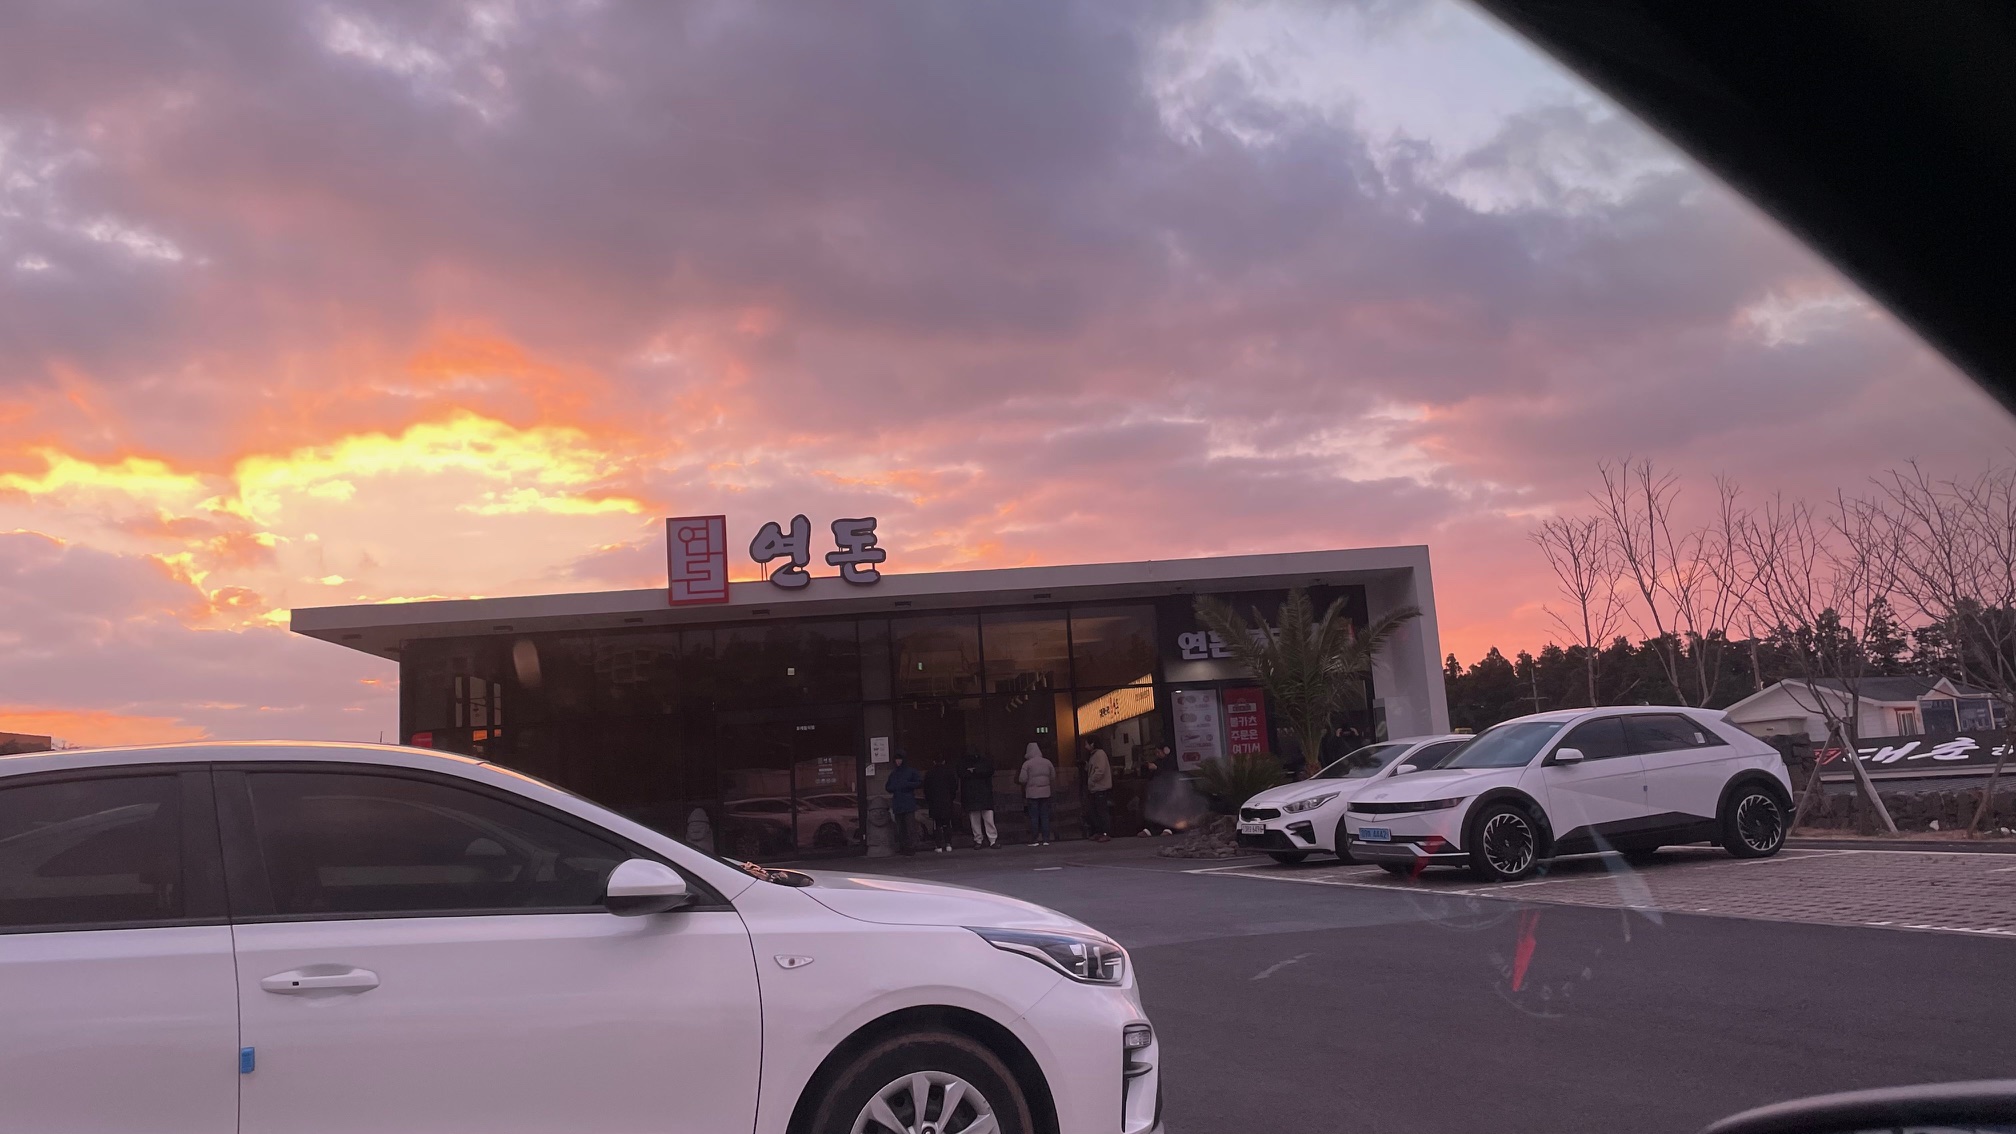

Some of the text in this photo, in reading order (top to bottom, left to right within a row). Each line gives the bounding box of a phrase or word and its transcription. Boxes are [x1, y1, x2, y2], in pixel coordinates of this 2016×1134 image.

[749, 514, 886, 590] 연돈
[1231, 729, 1258, 740] 주문은
[1232, 743, 1261, 754] 여기서
